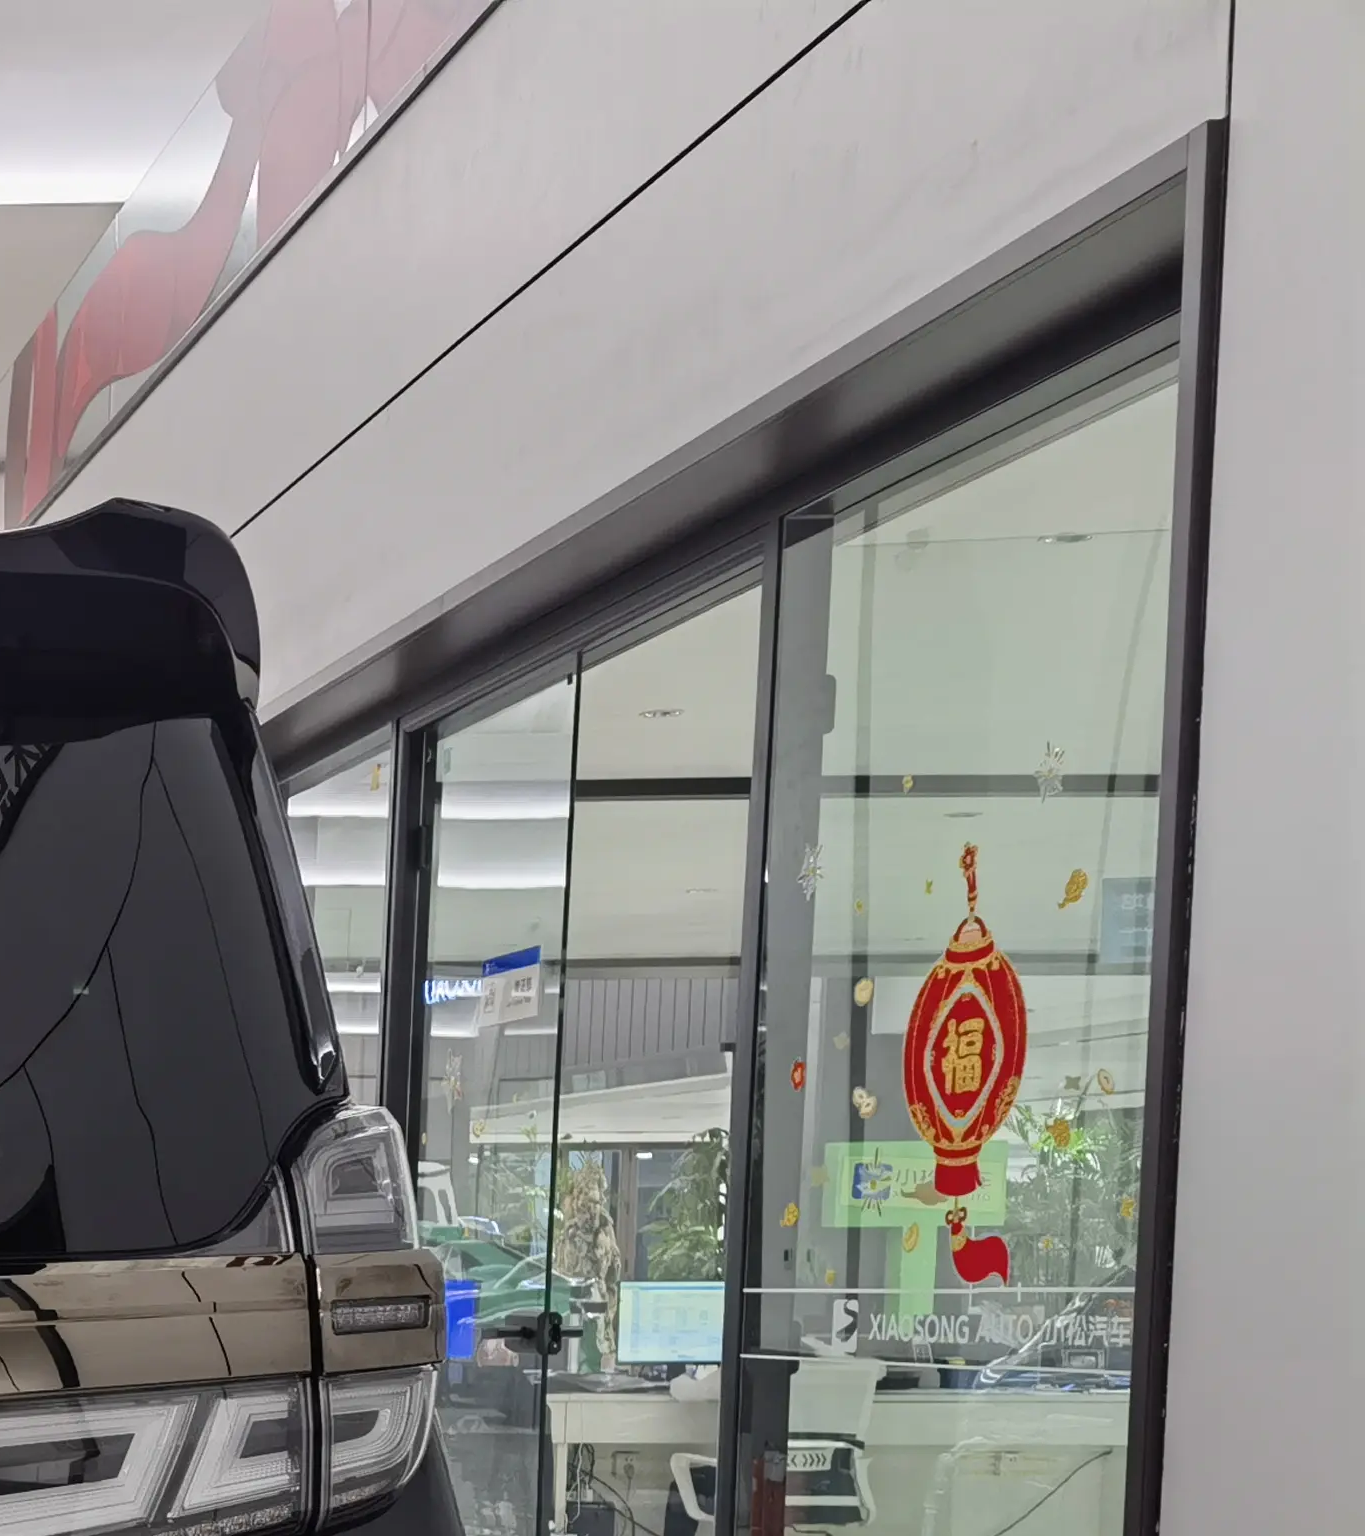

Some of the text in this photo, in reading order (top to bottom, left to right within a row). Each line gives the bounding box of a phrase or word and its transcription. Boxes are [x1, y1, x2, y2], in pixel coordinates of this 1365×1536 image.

[941, 1017, 985, 1096] 福
[869, 1312, 1034, 1345] XIAOSONG AUTO
